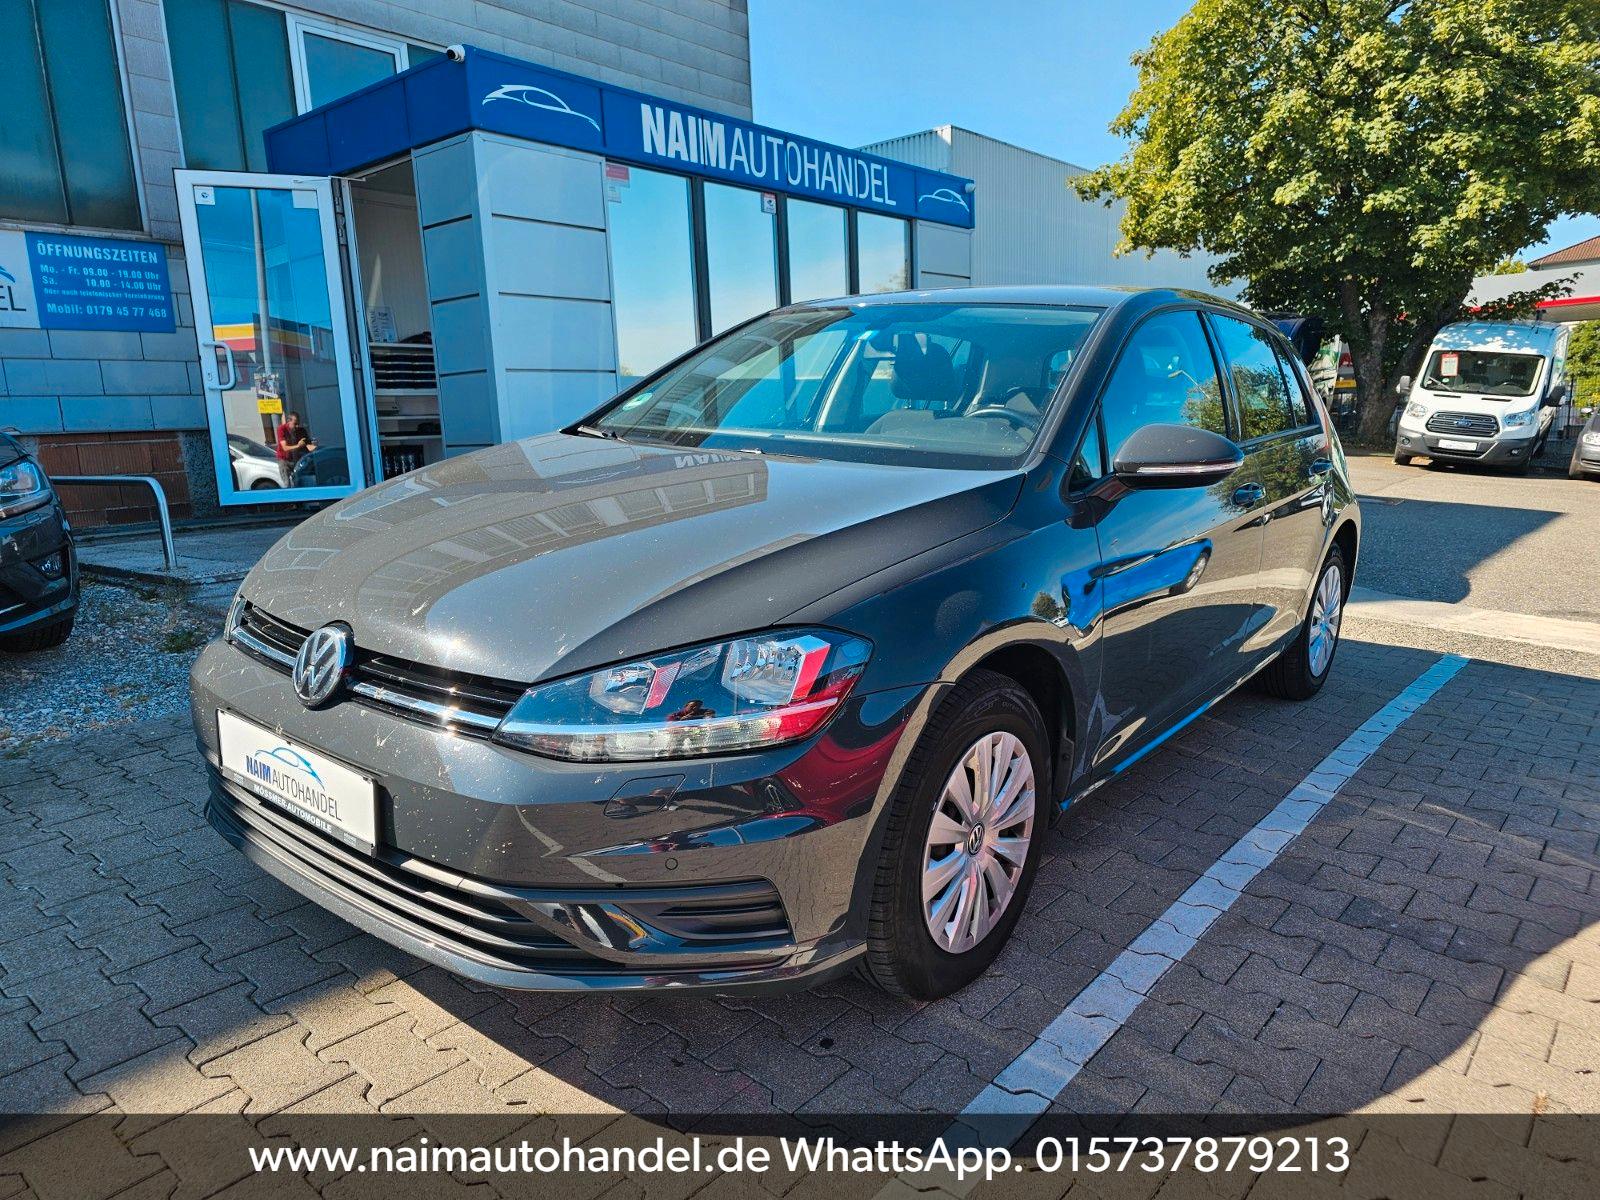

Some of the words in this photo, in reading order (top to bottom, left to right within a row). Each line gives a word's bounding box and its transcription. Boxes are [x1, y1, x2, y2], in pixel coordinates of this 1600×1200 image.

[641, 103, 726, 169] NAIM
[730, 128, 896, 206] AUTOHANDEL
[37, 240, 158, 264] ÖFFNUNGSZEITEN
[40, 264, 58, 274] Mo.
[68, 266, 81, 276] Fr.
[83, 267, 108, 277] 09.00
[144, 271, 160, 281] Uhr
[42, 276, 58, 286] Sa.
[146, 282, 161, 291] Uhr
[47, 303, 83, 315] Mobil:
[86, 305, 113, 317] 0179
[117, 307, 129, 317] 45
[132, 308, 144, 318] 77
[246, 755, 271, 784] NAIM
[272, 769, 342, 822] AUTOHANDEL
